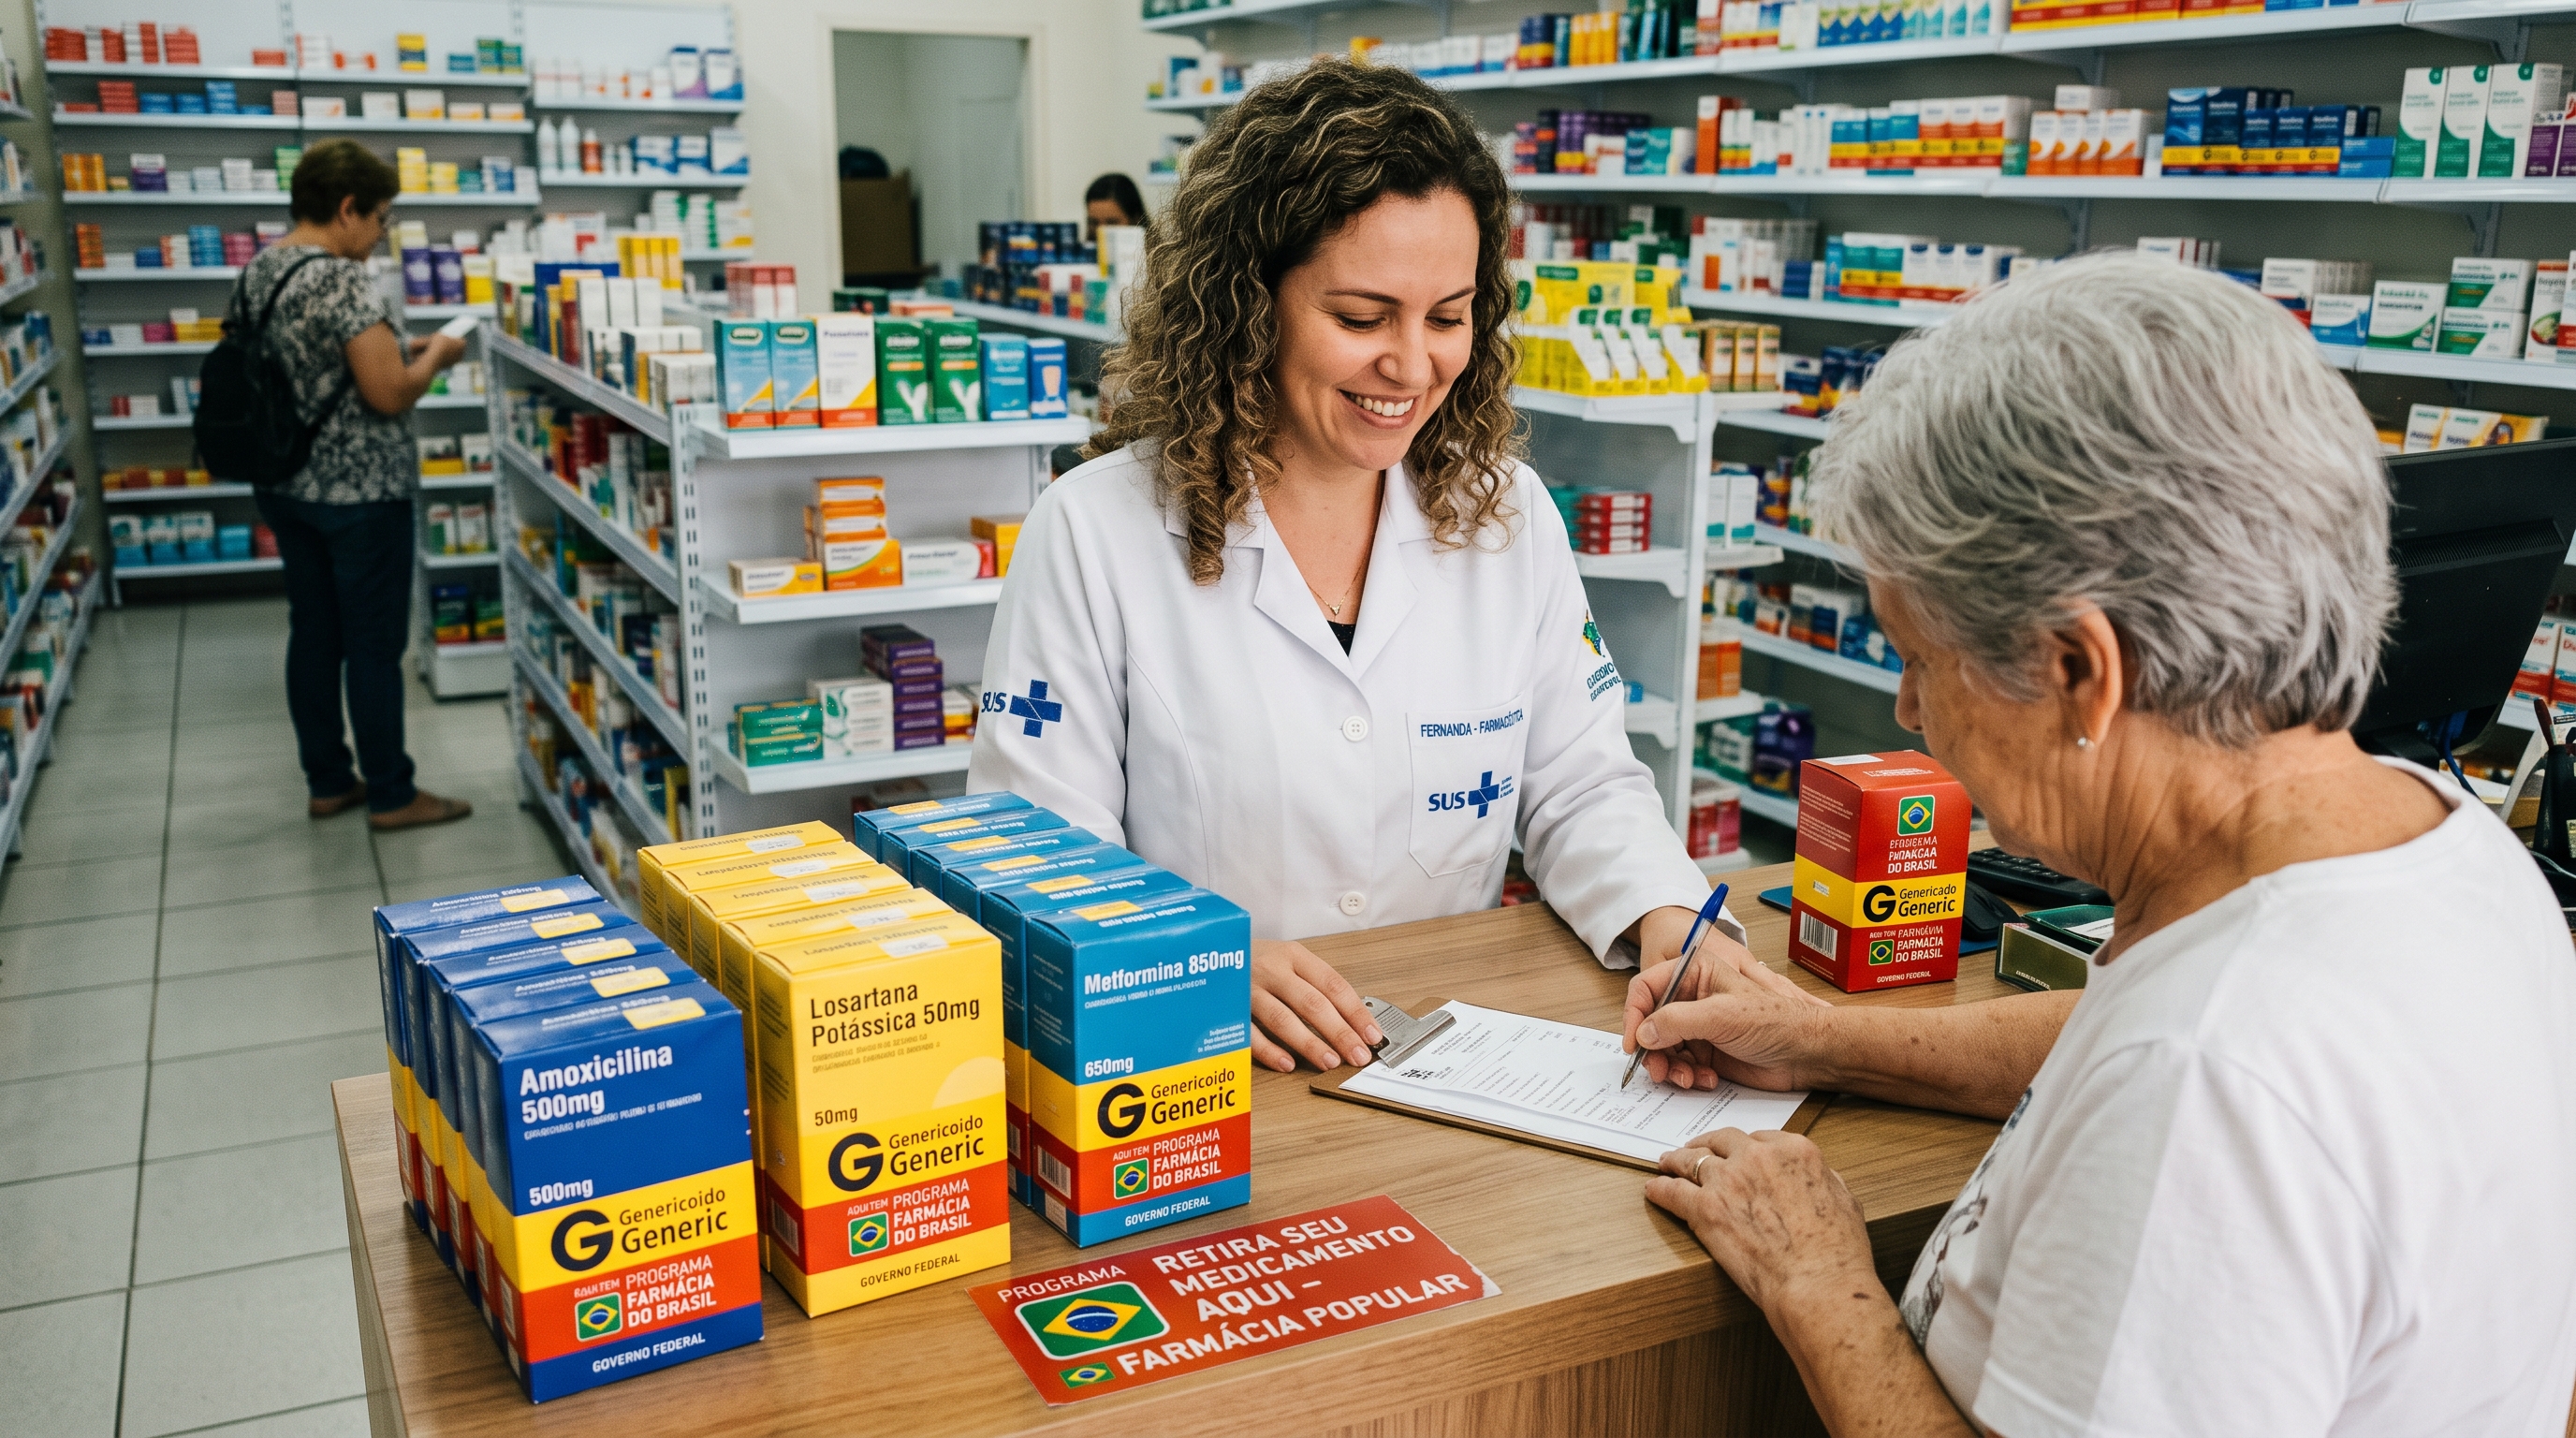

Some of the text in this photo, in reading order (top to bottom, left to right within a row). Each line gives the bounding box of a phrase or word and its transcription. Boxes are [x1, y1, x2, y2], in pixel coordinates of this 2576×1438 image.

[1421, 723, 1472, 737] FERNANDA
[1428, 791, 1466, 812] SUS
[1888, 858, 1938, 873] DO BRASIL
[1863, 885, 1896, 922] G
[1898, 897, 1955, 917] Generic
[1899, 884, 1956, 900] Genericado
[1085, 961, 1183, 995] Metformina
[1188, 949, 1245, 976] 850mg
[1895, 948, 1943, 962] DO BRASIL
[811, 984, 918, 1019] Losartana
[812, 999, 980, 1047] Potássica 50mg
[520, 1046, 673, 1096] Amoxicilina
[1085, 1056, 1134, 1078] 650mg
[1150, 1067, 1235, 1099] Genericoido
[521, 1090, 606, 1123] 500mg
[815, 1108, 857, 1126] 50mg
[1097, 1083, 1147, 1138] G
[1151, 1087, 1236, 1125] Generic
[889, 1115, 984, 1149] Genericoido
[1153, 1127, 1221, 1156] PROGRAMA
[828, 1132, 884, 1192] G
[890, 1135, 985, 1176] Generic
[1133, 1144, 1149, 1157] TEM
[1153, 1143, 1221, 1173] FARMÁCIA
[1153, 1161, 1222, 1190] DO BRASIL
[529, 1179, 593, 1207] 500mg
[619, 1187, 725, 1225] Genericoido
[870, 1197, 888, 1211] TEM
[893, 1178, 970, 1210] PROGRAMA
[893, 1196, 971, 1228] FARMÁCIA
[1125, 1196, 1210, 1227] GOVERNO FEDERAL
[550, 1209, 613, 1271] G
[622, 1208, 728, 1254] Generic
[894, 1213, 972, 1245] DO BRASIL
[1151, 1216, 1349, 1274] RETIRA SEU
[625, 1255, 712, 1289] PROGRAMA
[860, 1253, 960, 1287] GOVERNO FEDERAL
[1168, 1225, 1415, 1297] MEDICAMENTO
[626, 1272, 714, 1309] FARMÁCIA
[997, 1265, 1126, 1303] PROGRAMA
[1196, 1279, 1295, 1322] AQUI
[627, 1291, 717, 1328] DO BRASIL
[1116, 1273, 1470, 1375] FARMÁCIA POPULAR
[592, 1332, 706, 1372] GOVERNO FEDERAL
